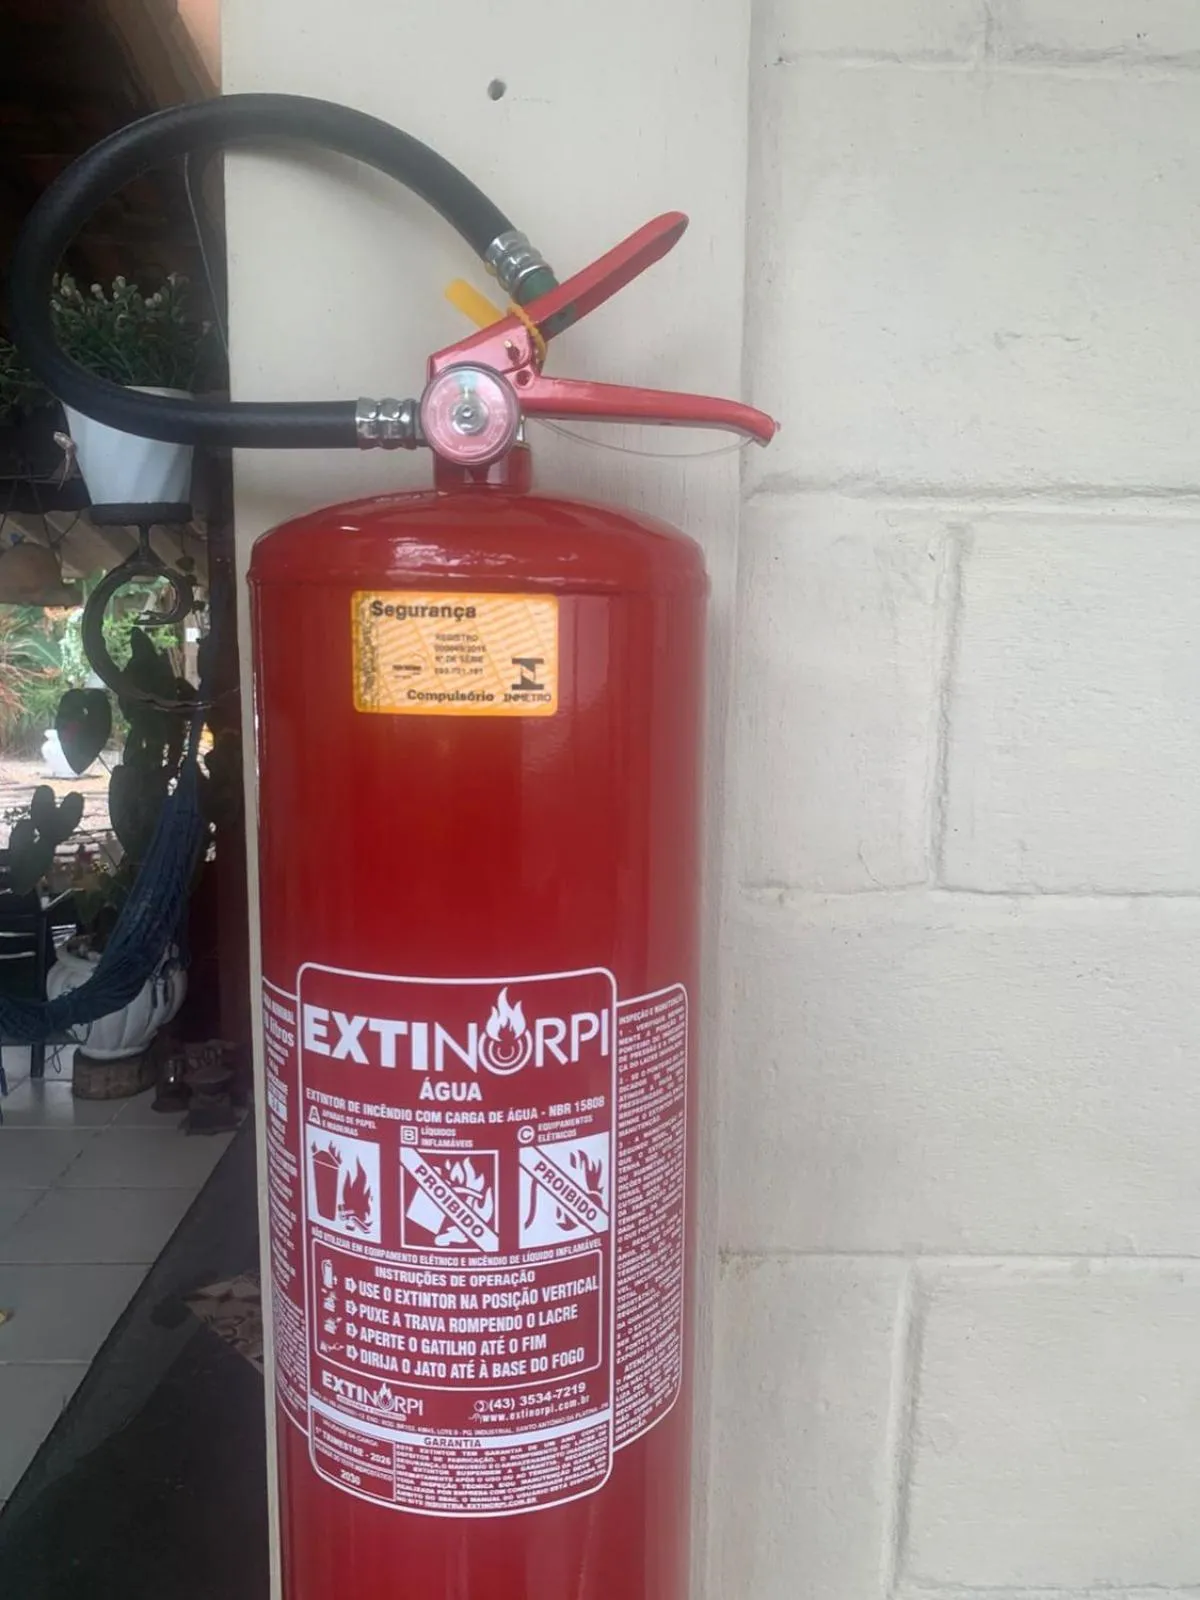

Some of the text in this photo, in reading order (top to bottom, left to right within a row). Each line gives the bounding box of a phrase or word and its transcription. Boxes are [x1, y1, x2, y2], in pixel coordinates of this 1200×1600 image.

[371, 600, 477, 622] Segurança
[407, 689, 551, 703] Compulsório INMETRO
[419, 1077, 483, 1101] ÁGUA
[306, 1087, 346, 1111] EXTINTOR
[347, 1100, 361, 1114] DE
[363, 1103, 412, 1122] INCÊNDIO
[415, 1109, 442, 1124] COM
[445, 1111, 485, 1124] CARGA
[488, 1111, 504, 1123] DE
[507, 1107, 538, 1122] ÁGUA
[549, 1102, 572, 1117] NBR
[309, 1105, 322, 1126] A
[415, 1164, 484, 1237] PROIBIDO
[534, 1160, 597, 1221] PROIBIDO
[364, 1246, 418, 1264] EQUIPAMENTO
[420, 1253, 459, 1267] ELÉTRICO
[460, 1257, 467, 1266] E
[468, 1254, 508, 1266] INCÊNDIO
[509, 1254, 520, 1264] DE
[522, 1249, 554, 1263] LÍQUIDO
[555, 1238, 602, 1257] INFLAMÁVEL
[375, 1266, 536, 1288] INSTRUÇÕES DE OPERAÇÃO
[358, 1280, 380, 1300] USE
[383, 1286, 391, 1302] O
[394, 1288, 457, 1310] EXTINTOR
[460, 1293, 479, 1310] NA
[482, 1287, 539, 1311] POSIÇÃO
[542, 1275, 599, 1301] VERTICAL
[359, 1303, 389, 1325] PUXE
[392, 1312, 401, 1328] A
[403, 1313, 446, 1333] TRAVA
[449, 1315, 523, 1333] ROMPENDO
[526, 1313, 535, 1328] O
[538, 1303, 578, 1327] LACRE
[360, 1326, 405, 1350] APERTE
[408, 1336, 418, 1353] O
[421, 1338, 476, 1356] GATILHO
[480, 1335, 505, 1356] ATÉ
[509, 1338, 518, 1354] O
[522, 1333, 547, 1352] FIM
[360, 1348, 399, 1373] DIRIJA
[401, 1357, 411, 1375] O
[413, 1360, 447, 1378] JATO
[450, 1359, 476, 1379] ATÉ
[479, 1359, 489, 1379] À
[492, 1359, 527, 1378] BASE
[530, 1356, 548, 1373] DO
[552, 1347, 585, 1369] FOGO
[482, 1394, 590, 1422] www.extinorpi.com.br
[489, 1382, 586, 1412] (43) 3534-7219
[424, 1437, 482, 1448] GARANTIA
